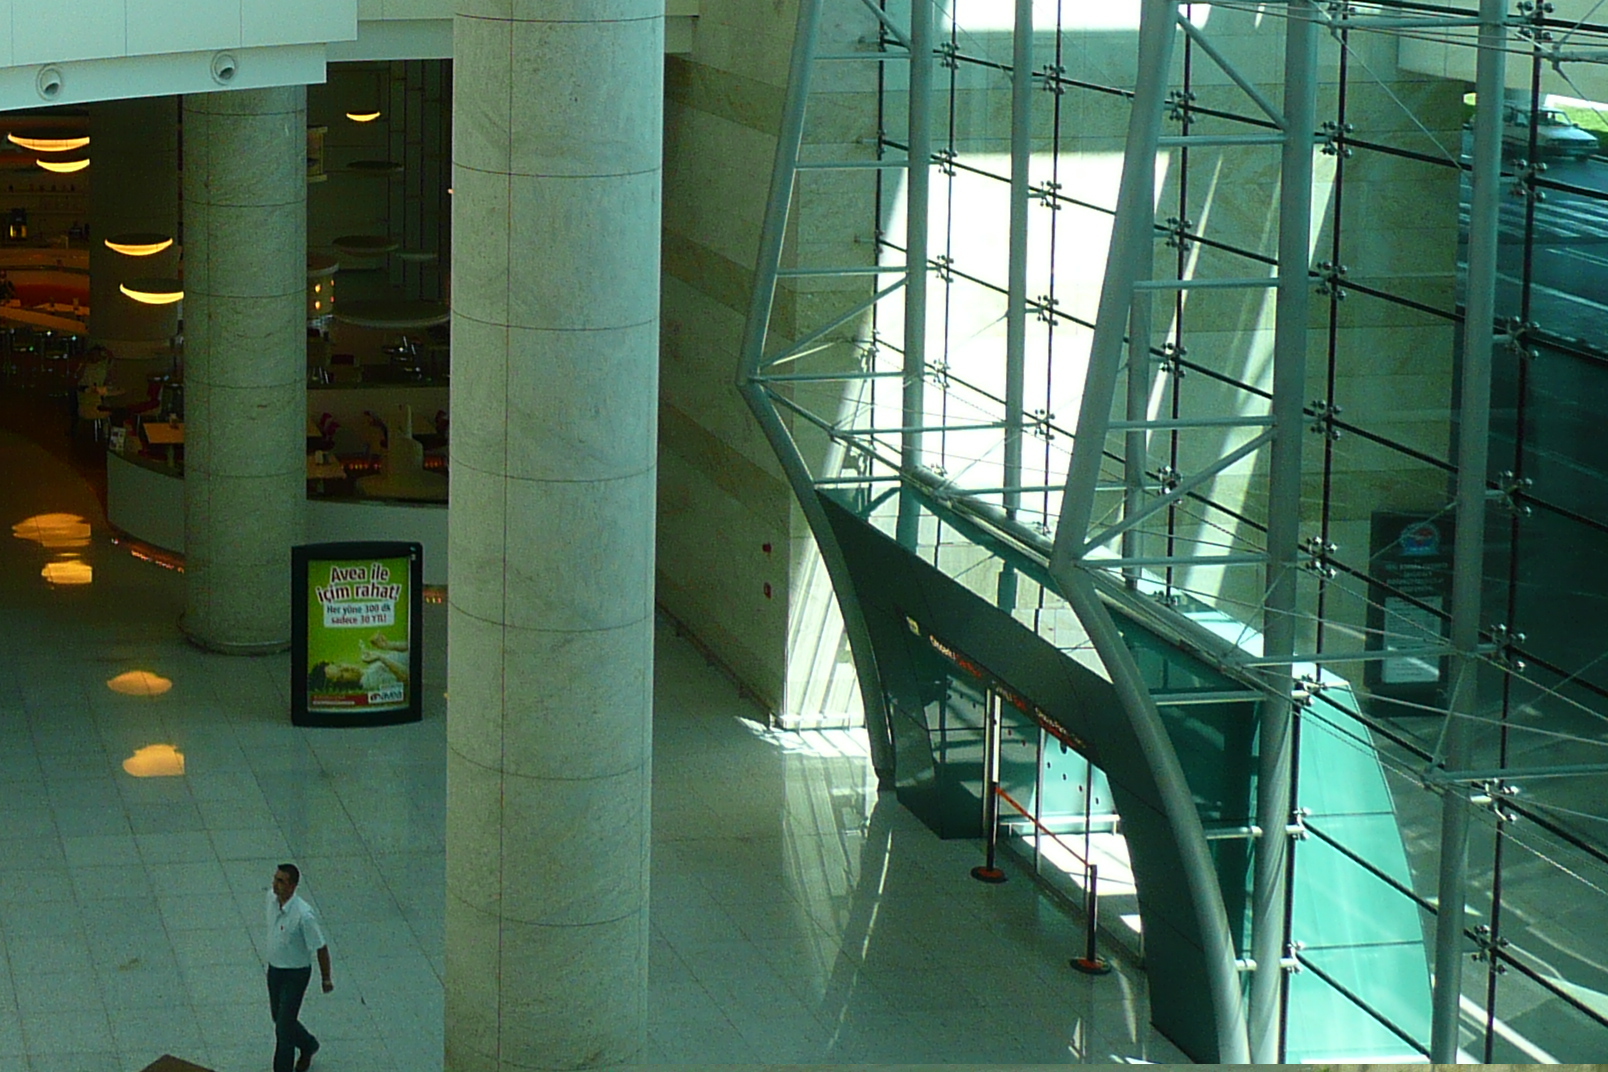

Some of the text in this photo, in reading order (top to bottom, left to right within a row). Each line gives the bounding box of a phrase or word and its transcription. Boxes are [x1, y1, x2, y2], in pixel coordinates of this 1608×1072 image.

[331, 564, 389, 583] Avea ile
[317, 582, 401, 603] içim rahat!
[327, 605, 341, 614] Her
